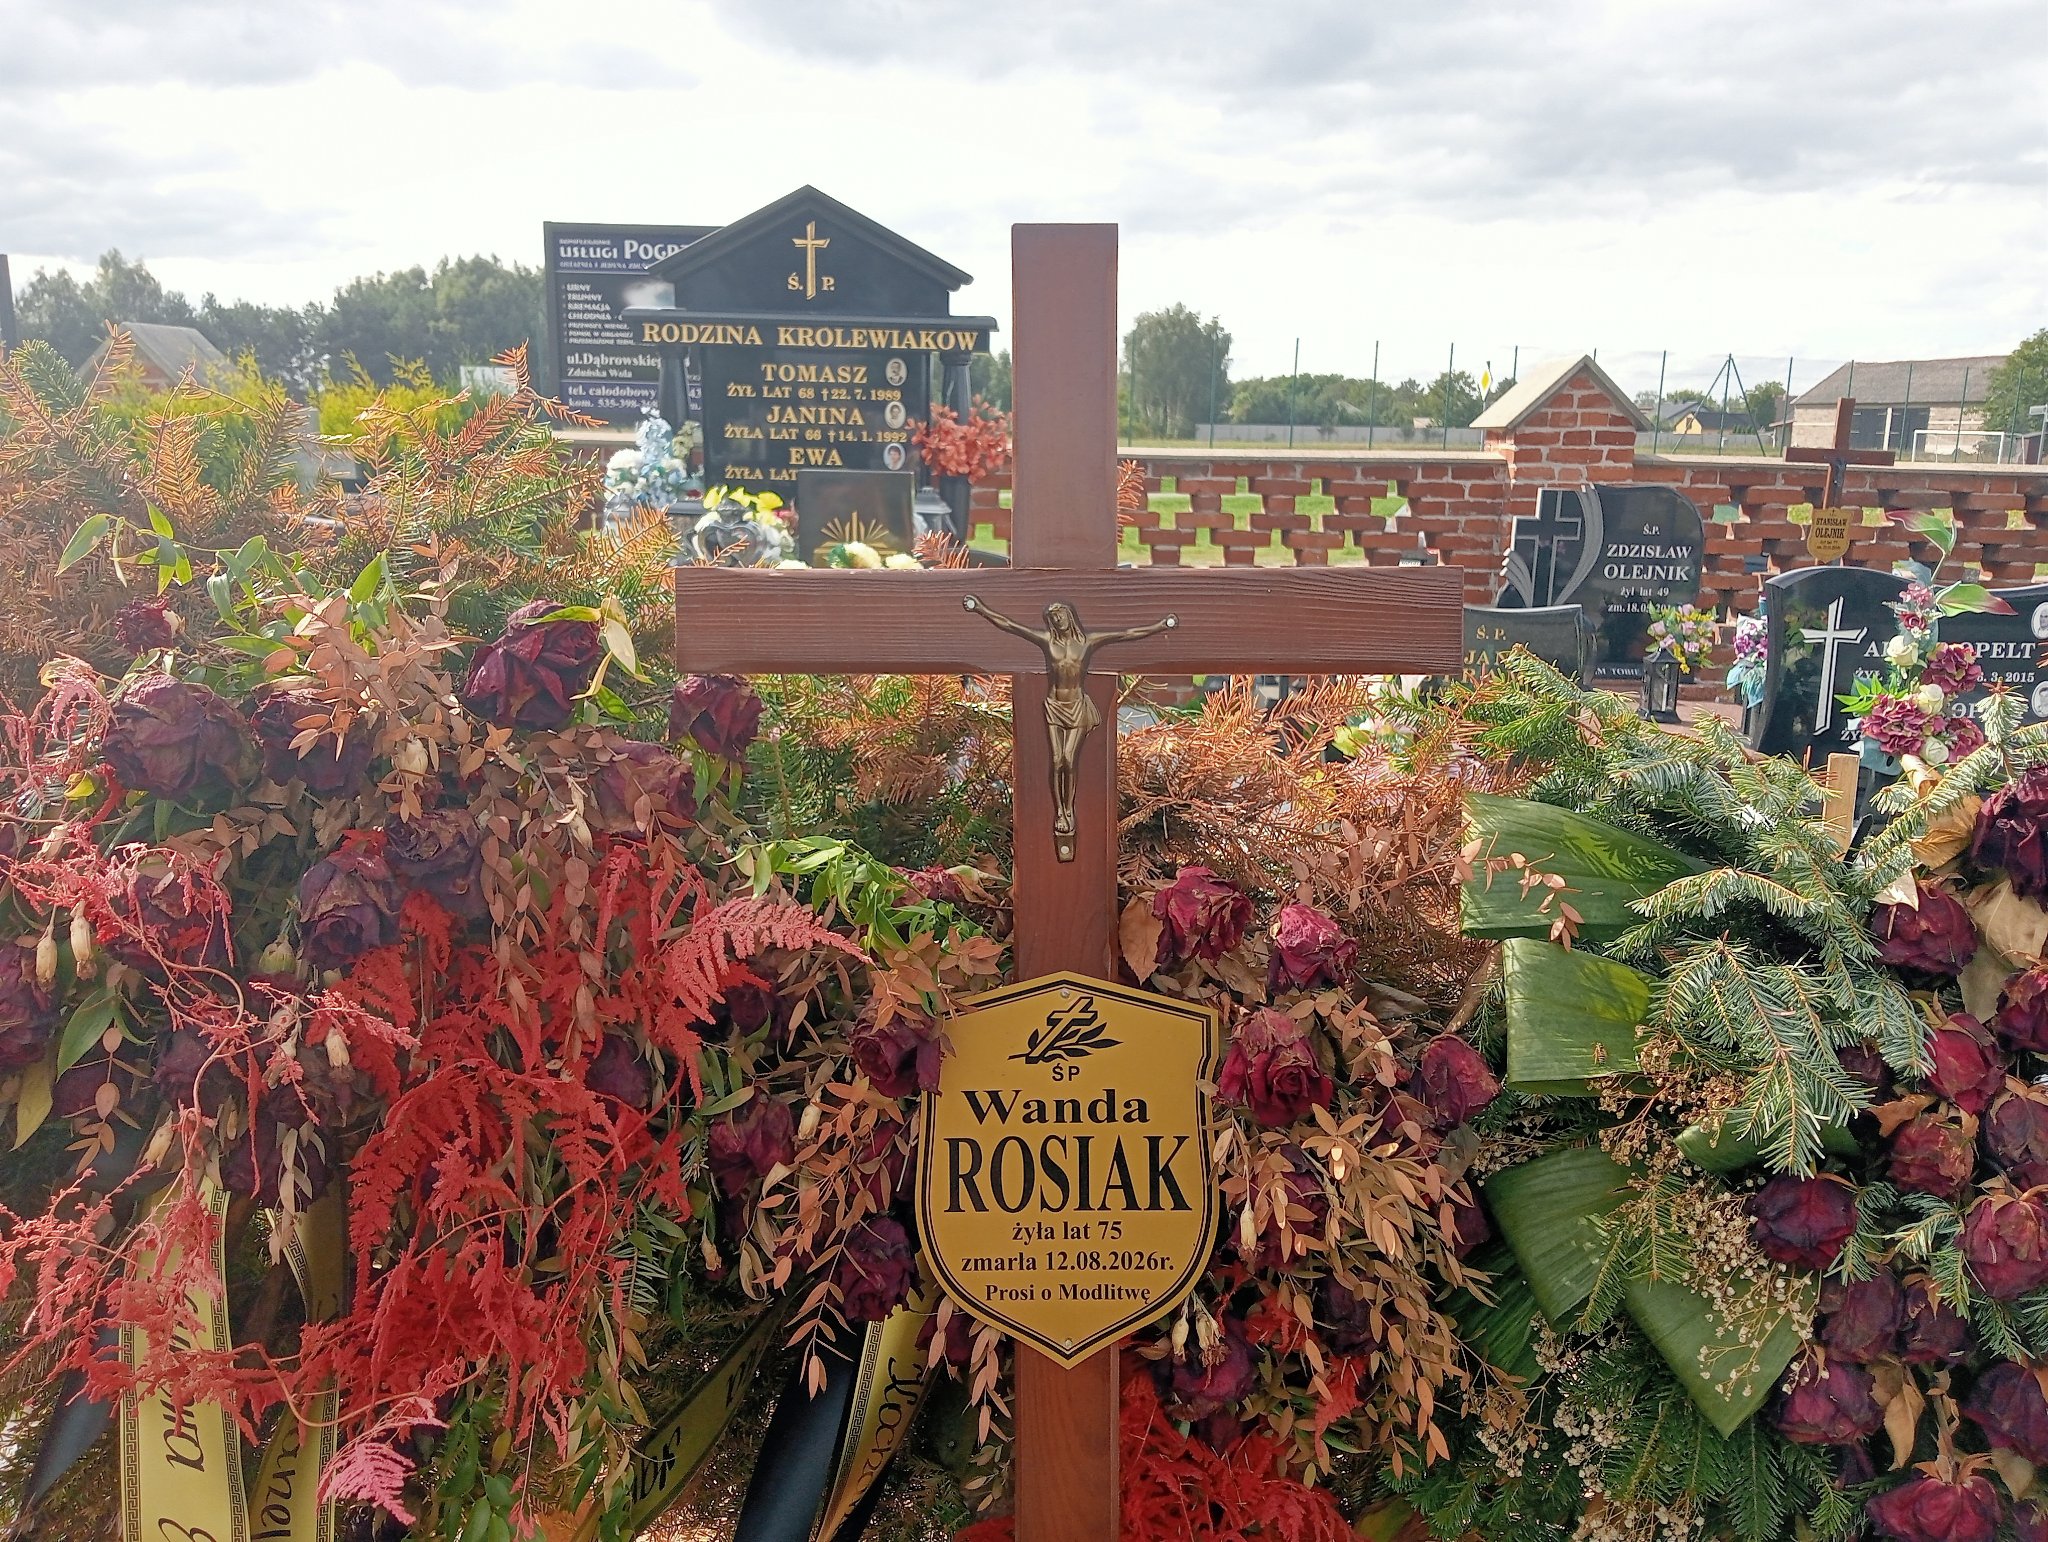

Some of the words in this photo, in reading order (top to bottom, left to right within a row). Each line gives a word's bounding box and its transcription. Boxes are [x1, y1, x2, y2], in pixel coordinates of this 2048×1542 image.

[787, 271, 804, 290] Ś.
[821, 276, 835, 291] P.
[642, 323, 763, 345] RODZINA
[761, 363, 868, 384] TOMASZ
[726, 382, 756, 398] ŻYŁ
[762, 386, 792, 398] LAT
[870, 389, 902, 401] 1989
[766, 405, 865, 426] JANINA
[724, 422, 765, 440] ŻYŁA
[770, 428, 799, 440] LAT
[876, 431, 907, 443] 1992
[789, 447, 843, 466] EWA
[724, 464, 764, 480] ŻYŁA
[770, 468, 799, 481] LAT
[1603, 563, 1691, 581] OLEJNIK
[1639, 586, 1653, 597] lat
[1494, 628, 1506, 640] P.
[2005, 671, 2035, 683] 2015
[1051, 1063, 1081, 1082] ŚP
[960, 1088, 1150, 1125] Wanda
[944, 1133, 1193, 1214] ROSIAK
[1012, 1221, 1055, 1245] żyła
[1062, 1221, 1090, 1240] lat
[1098, 1220, 1122, 1240] 75
[961, 1252, 1037, 1271] zmarła
[1045, 1251, 1174, 1271] 12.08.2026r.
[985, 1284, 1034, 1300] Prosi
[1041, 1288, 1051, 1300] o
[1059, 1284, 1151, 1304] Modlitwę
